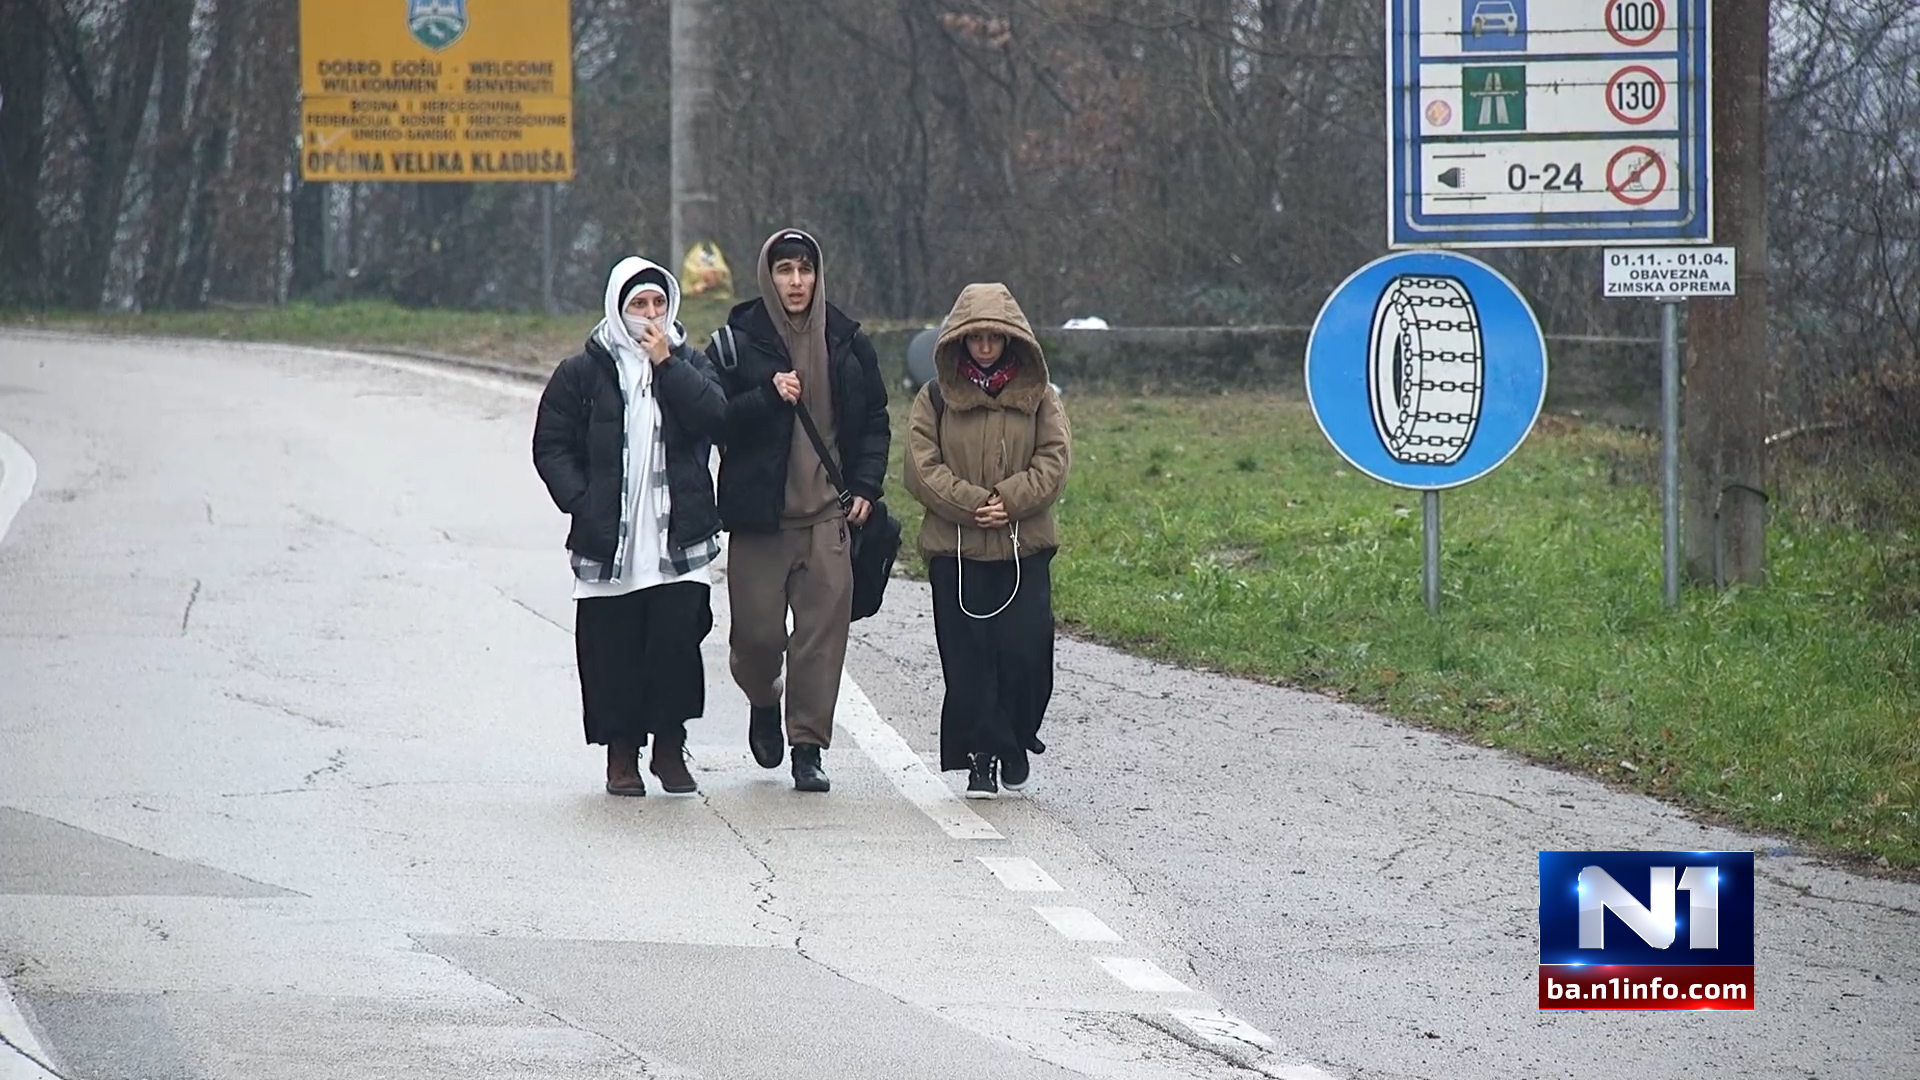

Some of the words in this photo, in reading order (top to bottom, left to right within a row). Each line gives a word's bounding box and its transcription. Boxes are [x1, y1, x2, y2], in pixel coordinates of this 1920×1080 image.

[1616, 2, 1654, 31] 100
[318, 60, 381, 76] DOBRO
[392, 58, 442, 76] DOŠLI
[469, 61, 554, 76] WELCOME
[323, 77, 438, 92] WILLKOMMEN
[464, 79, 554, 93] BENVENUTI
[1616, 80, 1656, 111] 130
[392, 152, 464, 174] VELIKA
[471, 149, 567, 174] KLADUŠA
[1508, 162, 1584, 192] 0-24
[1611, 254, 1661, 266] 01.11.
[1678, 253, 1728, 265] 01.04.
[1630, 269, 1709, 280] OBAVEZNA
[1608, 282, 1664, 292] ZIMSKA
[1669, 282, 1731, 292] OPREMA
